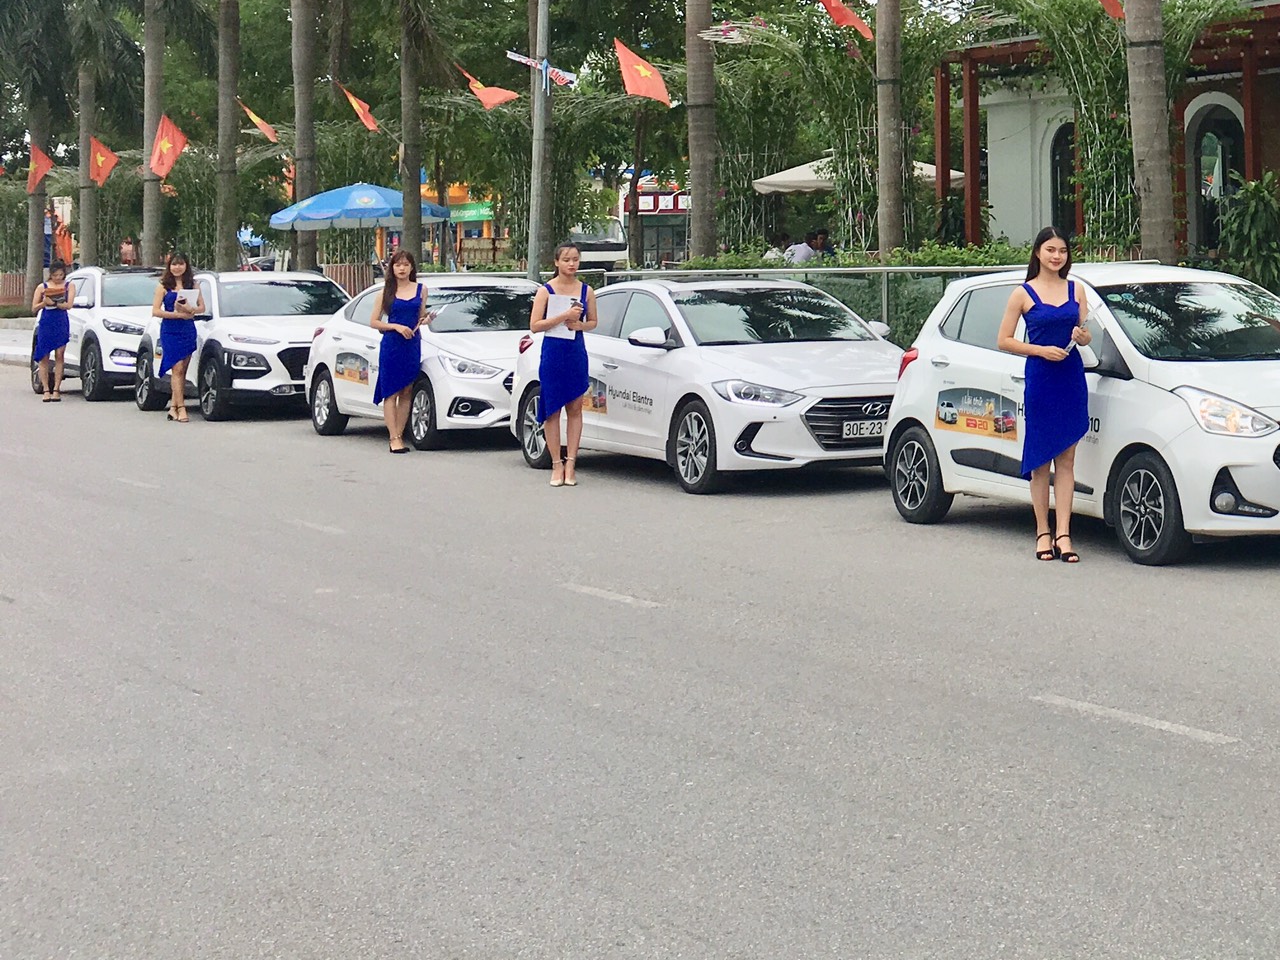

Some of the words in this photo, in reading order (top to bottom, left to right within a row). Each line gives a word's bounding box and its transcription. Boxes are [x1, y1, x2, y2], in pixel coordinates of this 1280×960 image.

[608, 385, 632, 400] Hyundai
[632, 391, 653, 407] Elantra
[845, 421, 887, 436] 30E-23
[1087, 416, 1100, 433] 10
